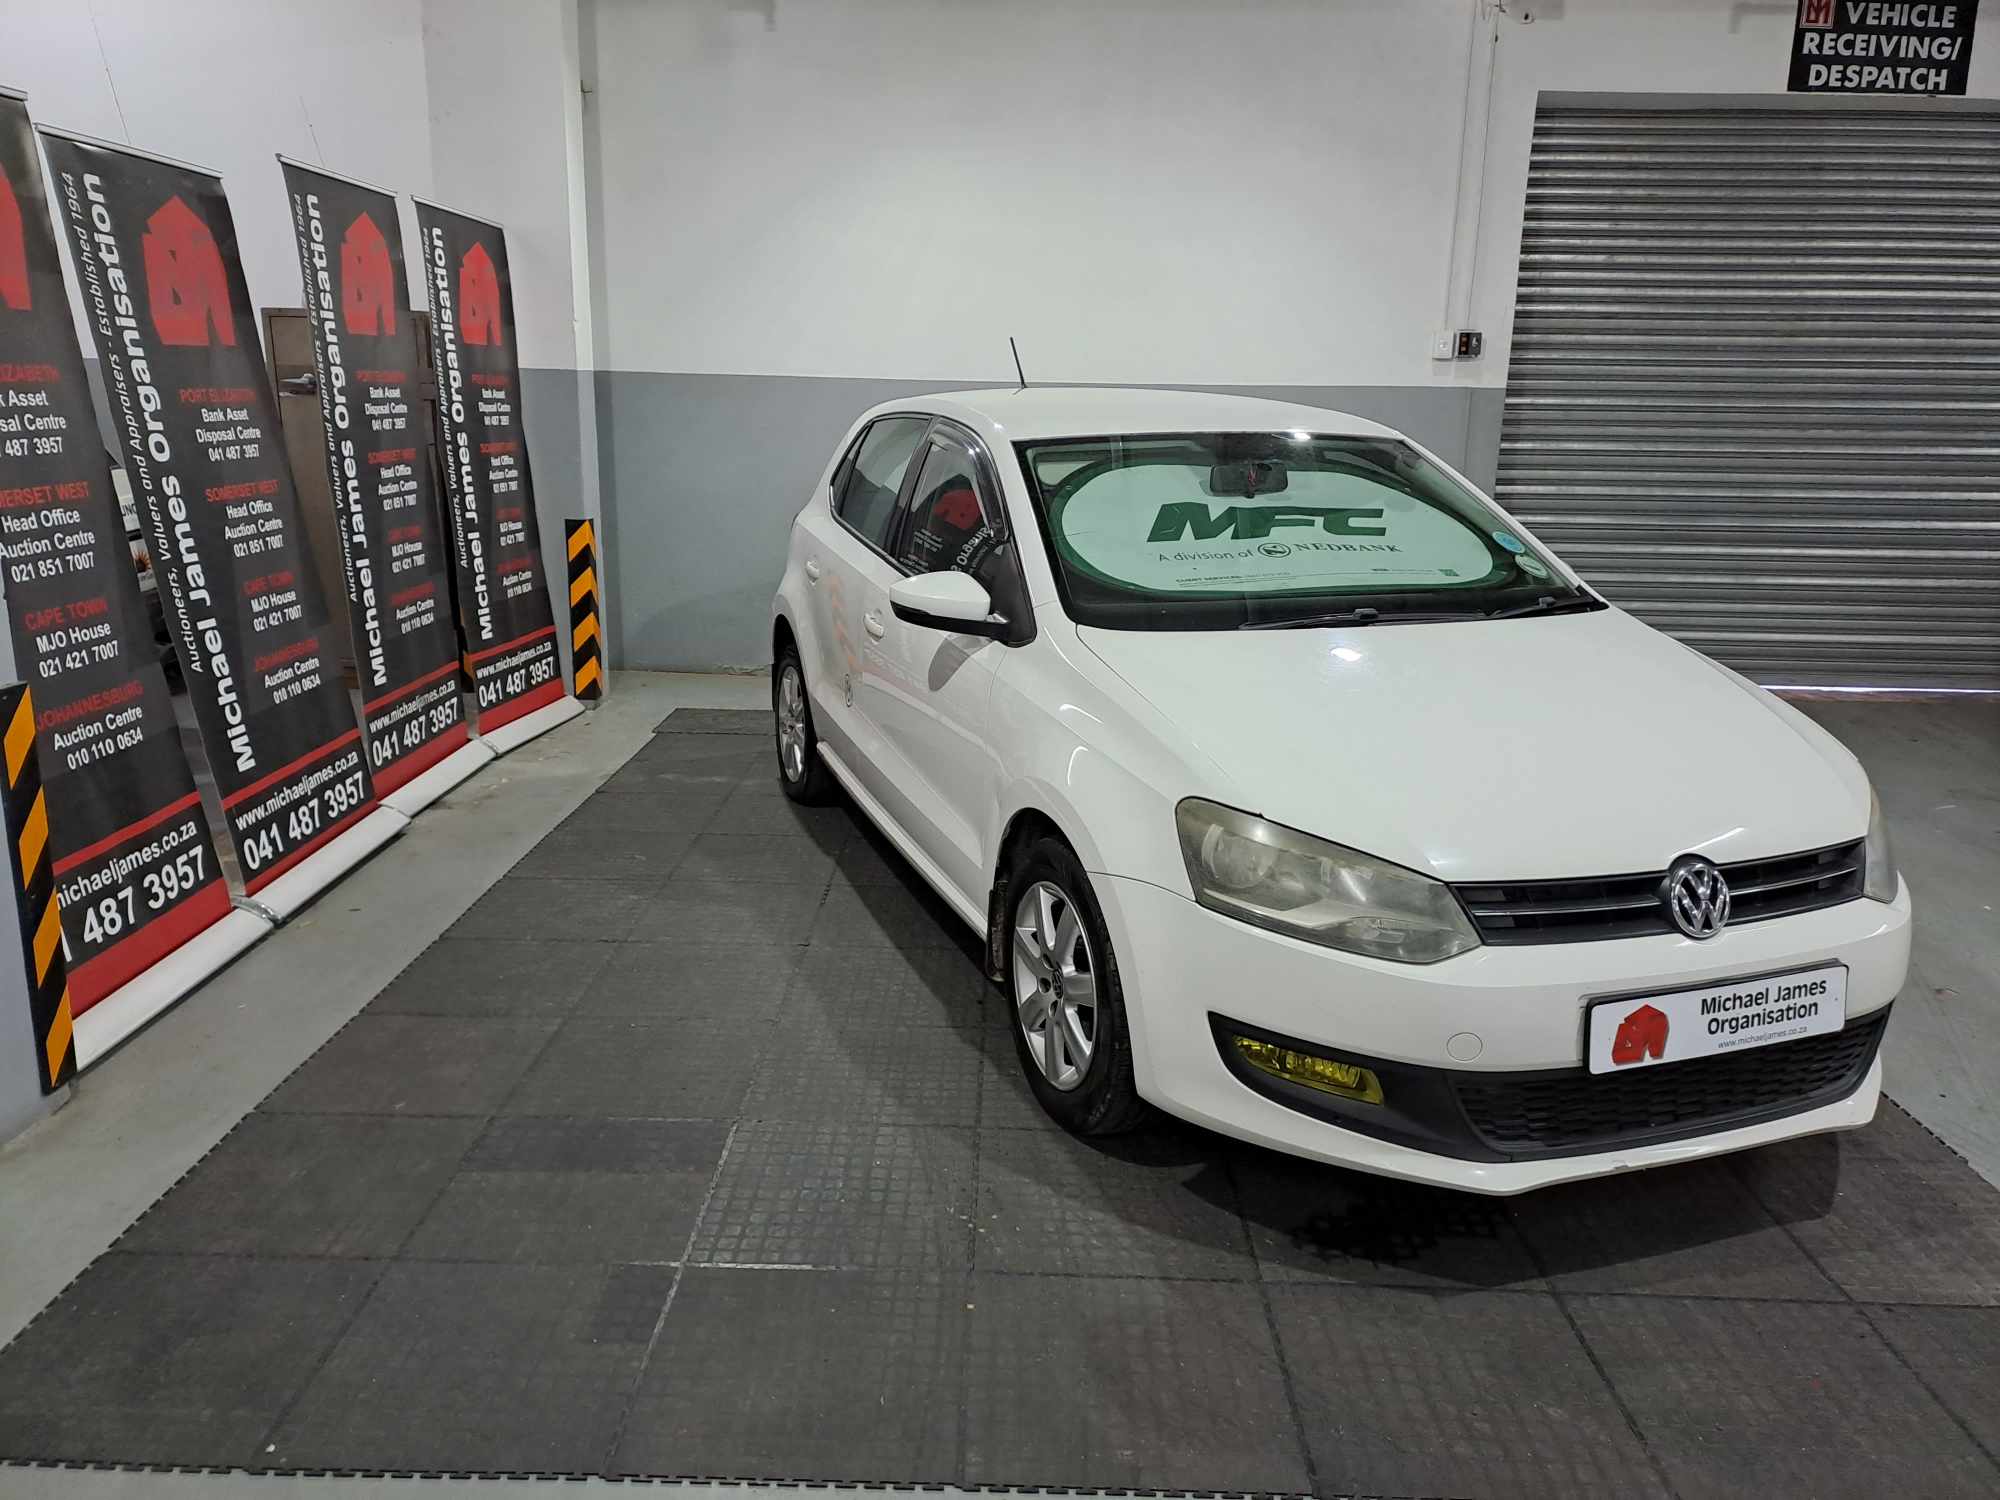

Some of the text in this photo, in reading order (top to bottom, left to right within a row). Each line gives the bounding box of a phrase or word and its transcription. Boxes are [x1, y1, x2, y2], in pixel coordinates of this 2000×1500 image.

[1846, 2, 1957, 29] VEHICLE
[1802, 32, 1962, 60] RECEIVING/
[1808, 64, 1948, 91] DESPATCH
[60, 171, 84, 220] 1964
[294, 193, 305, 233] 1964
[73, 225, 113, 338] Established
[299, 237, 318, 326] Established
[314, 340, 331, 419] Appraisers
[9, 390, 48, 407] Asset
[108, 352, 142, 450] Appraisers
[202, 407, 248, 422] Bank Asset
[24, 413, 66, 431] Centre
[196, 426, 262, 446] Disposal Centre
[325, 422, 336, 451] and
[432, 227, 493, 641] Michael James Organisation
[441, 416, 451, 441] and
[5, 437, 62, 456] 487 3957
[209, 447, 224, 462] 041
[225, 445, 241, 460] 487
[306, 193, 388, 687] Michael James Organisation
[83, 172, 256, 773] Michael James Organisation
[133, 454, 152, 490] and
[330, 456, 344, 509] Valuers
[446, 444, 457, 490] Valuers
[55, 482, 89, 500] WEST
[1, 508, 80, 533] Head Office
[226, 500, 273, 519] Head Office
[147, 495, 172, 560] Valuers
[225, 517, 283, 540] Auction Centre
[0, 531, 95, 559] Auction Centre
[233, 543, 248, 558] 021
[249, 539, 265, 555] 851
[340, 514, 358, 602] Auctioneers,
[1159, 542, 1402, 562] A division of NEDBANK
[11, 551, 94, 583] 021 851 7007
[251, 590, 296, 613] MJO House
[24, 607, 64, 630] CAPE
[167, 567, 203, 673] Auctioneers,
[254, 616, 268, 632] 021
[268, 610, 283, 628] 421
[37, 622, 111, 654] MJO House
[39, 640, 119, 679] 021 421 7007
[264, 656, 320, 688] Auction Centre
[273, 687, 288, 705] 010
[478, 657, 554, 708] 041 487 3957
[53, 705, 143, 752] Auction Centre
[372, 697, 458, 768] 041 487 3957
[67, 727, 144, 770] 010 110 0634
[235, 750, 359, 832] www.michaeljames.co.za
[243, 770, 365, 871] 041 487 3957
[56, 820, 197, 912] michaeljames.co.za
[83, 845, 204, 945] 487 3957
[1701, 978, 1827, 1016] Michael James
[1707, 1000, 1818, 1035] Organisation
[1718, 1026, 1808, 1050] www.michaeljames.co.za
